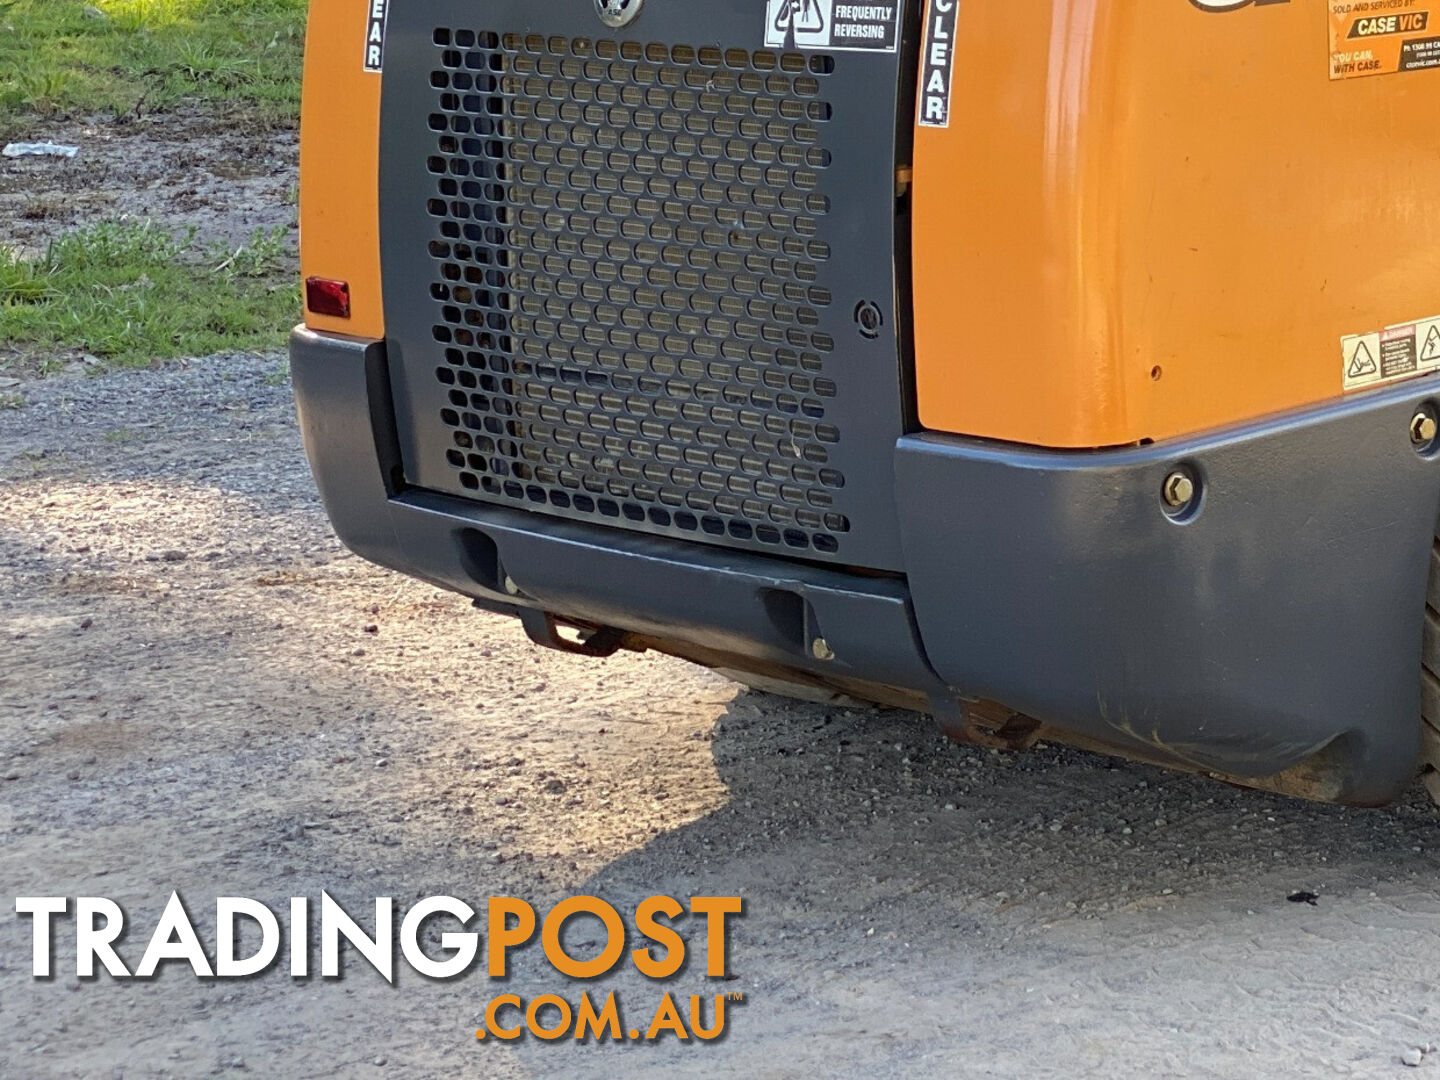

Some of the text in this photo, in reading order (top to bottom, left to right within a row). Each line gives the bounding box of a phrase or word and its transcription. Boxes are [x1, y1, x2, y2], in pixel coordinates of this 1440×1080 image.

[835, 5, 893, 22] FREQUENTLY
[1333, 4, 1351, 15] SOLD
[1353, 2, 1369, 12] AND
[834, 23, 885, 39] REVERSING
[1358, 13, 1423, 35] CASE VIC
[1334, 62, 1356, 74] WITH
